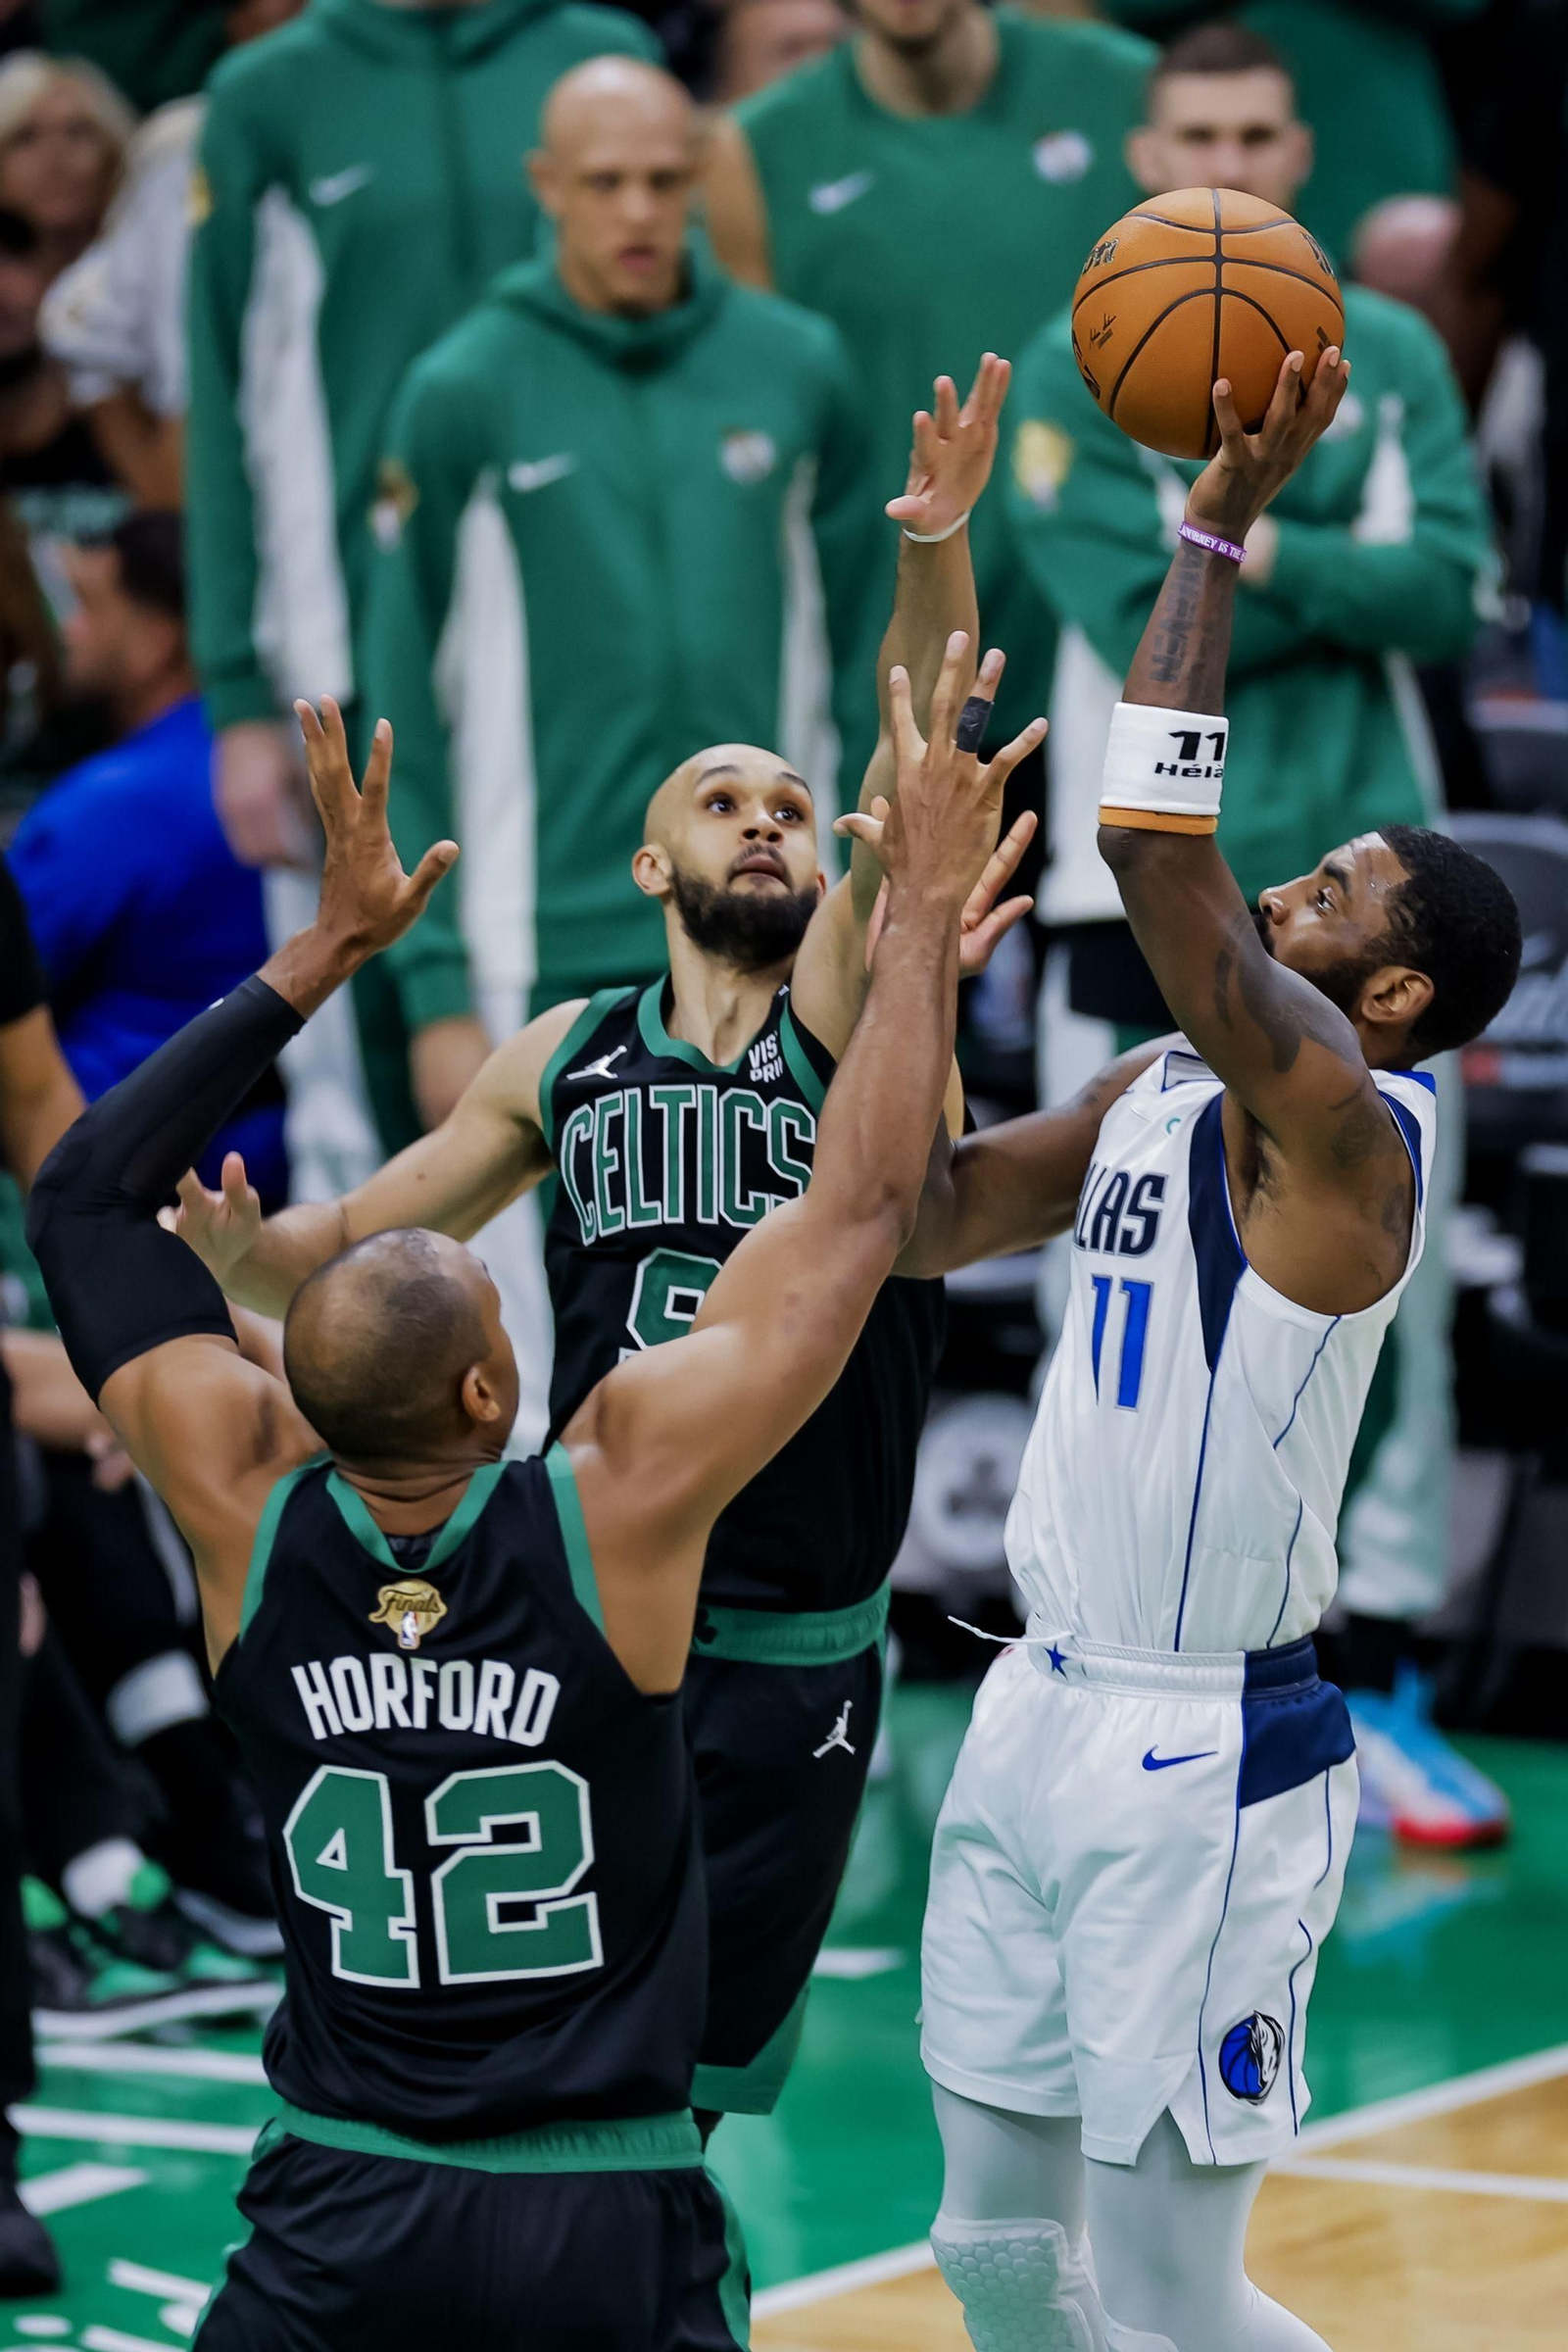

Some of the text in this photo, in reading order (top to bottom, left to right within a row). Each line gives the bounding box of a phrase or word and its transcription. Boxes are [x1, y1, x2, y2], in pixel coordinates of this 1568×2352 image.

[1217, 541, 1229, 554] IS
[1167, 730, 1226, 761] 11
[749, 1029, 778, 1070] VIS
[560, 1084, 816, 1247] CELTICS
[1091, 1273, 1154, 1412] 11
[373, 1588, 442, 1619] Finals
[290, 1652, 561, 1747] HORFORD
[282, 1760, 604, 1989] 42
